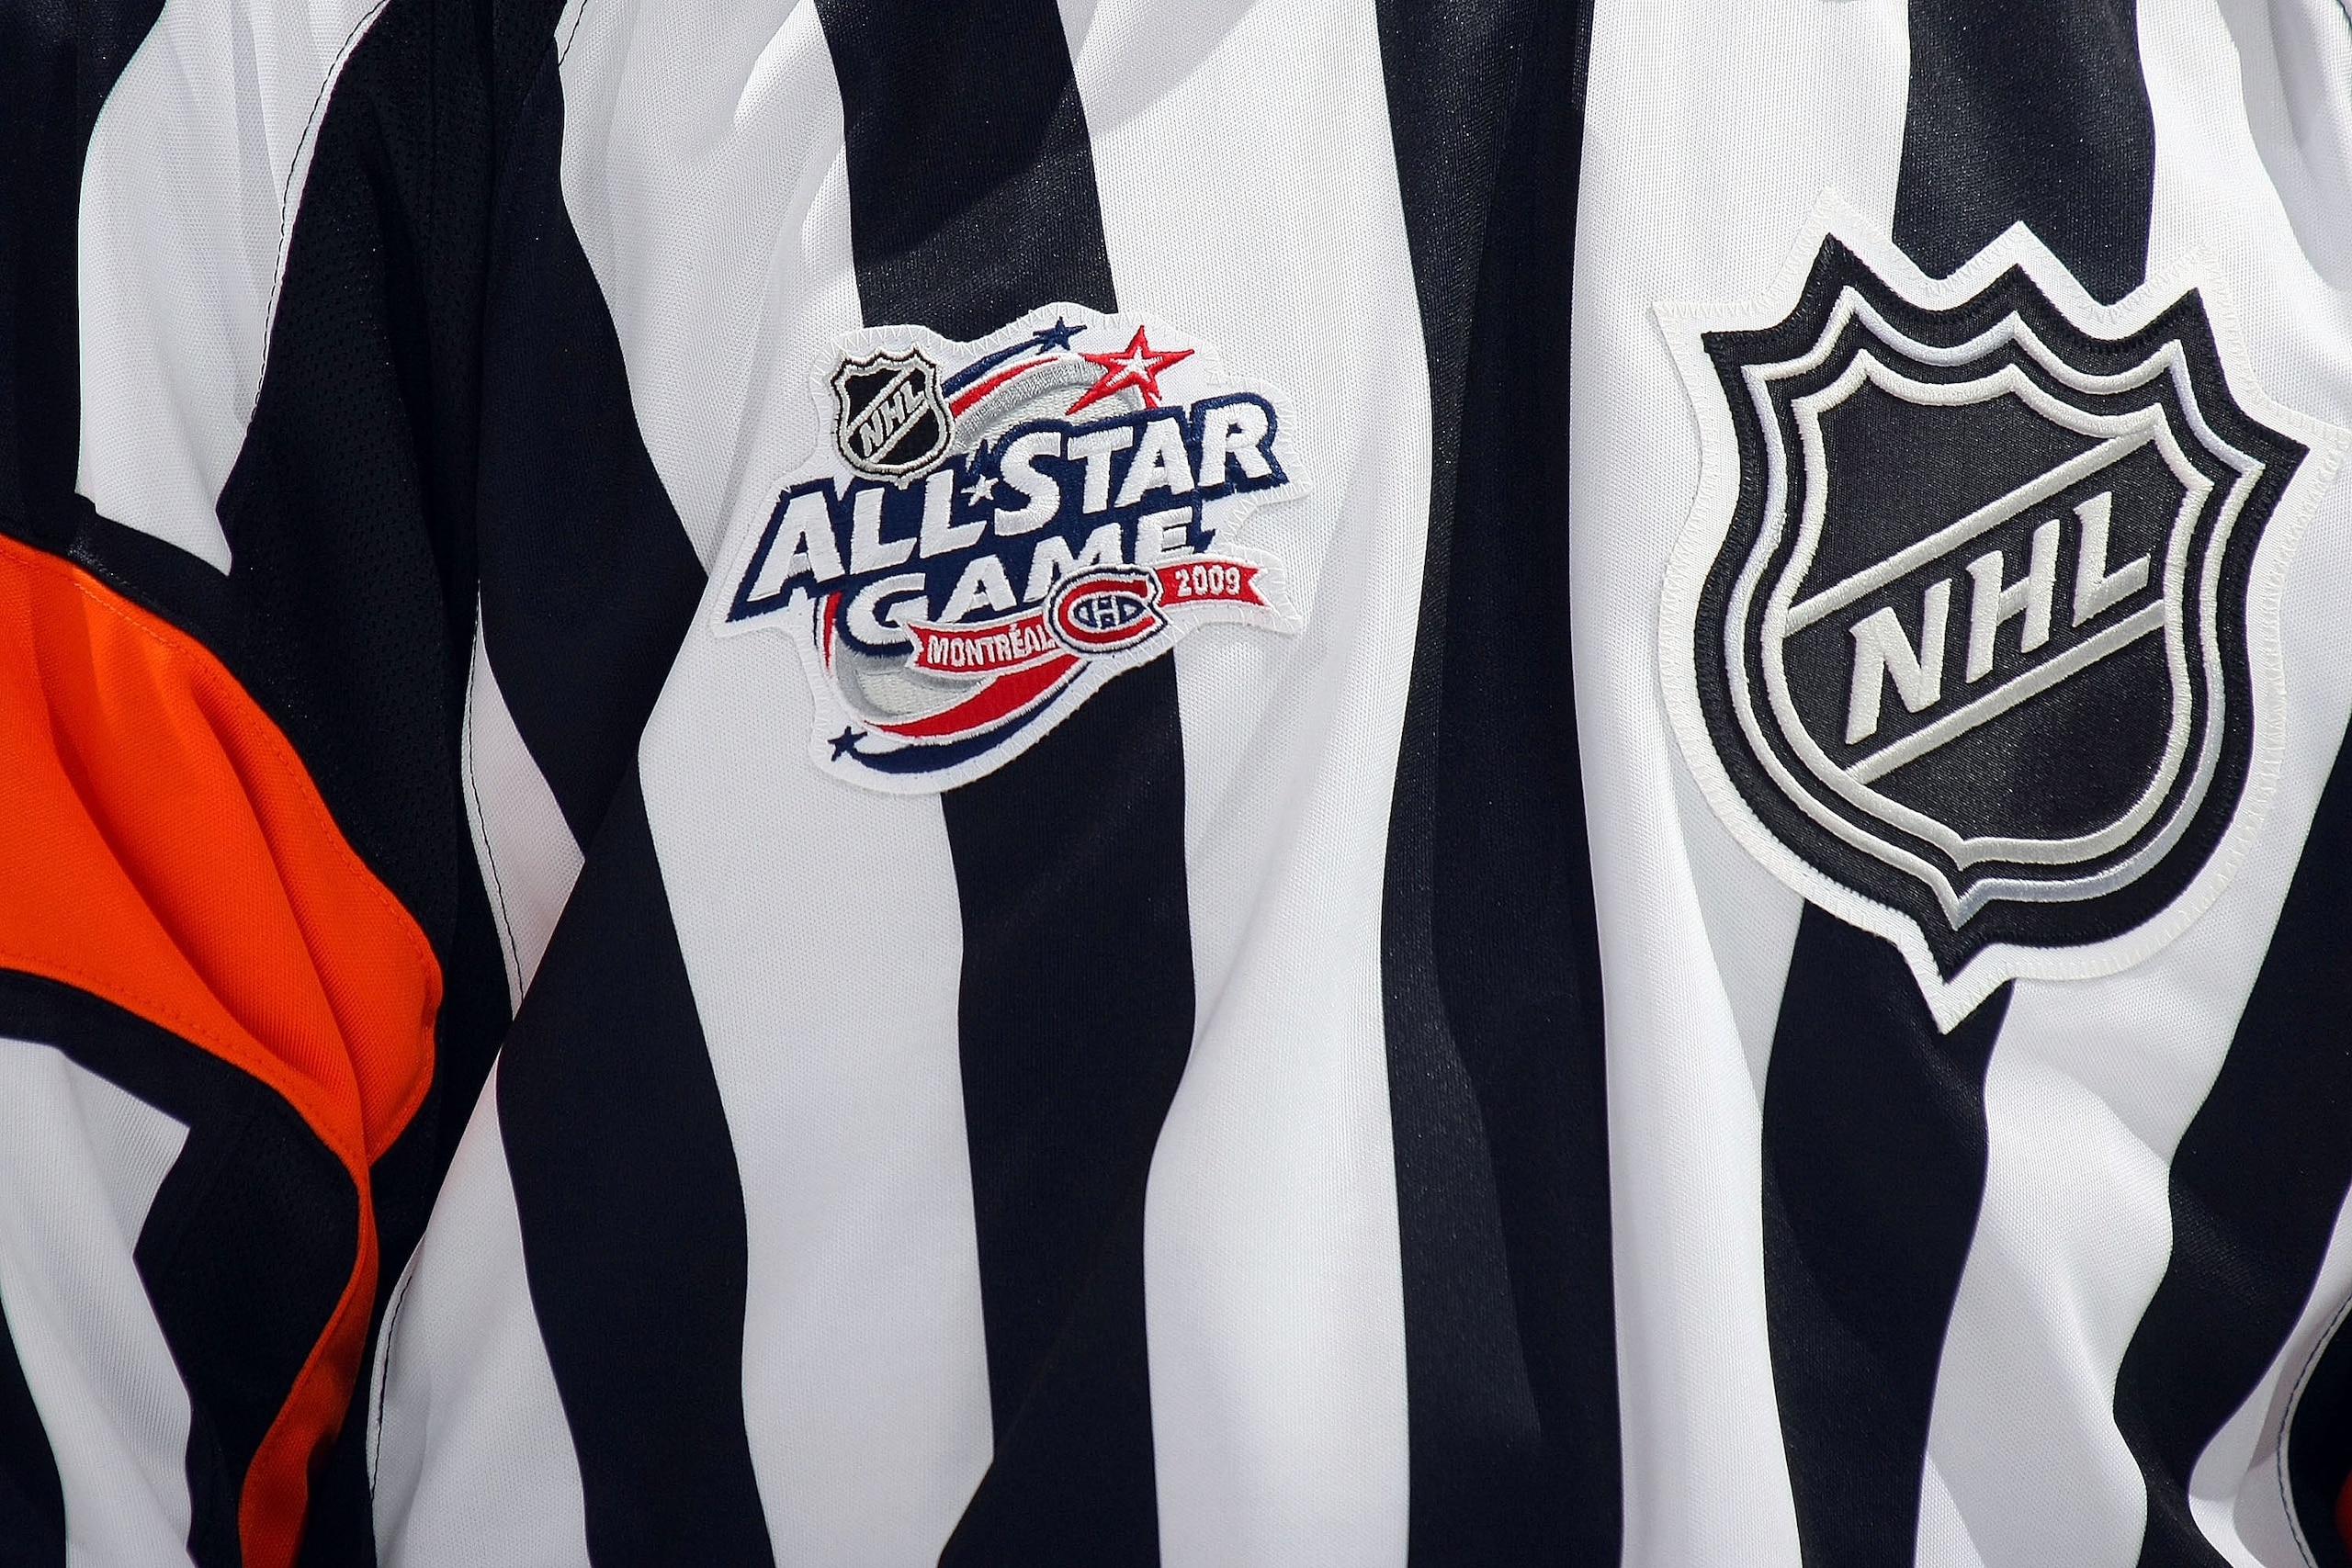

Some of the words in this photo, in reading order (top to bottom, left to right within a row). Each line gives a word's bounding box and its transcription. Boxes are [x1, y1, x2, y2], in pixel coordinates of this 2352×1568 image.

[859, 380, 925, 457] NHL
[750, 469, 989, 603] ALL
[993, 400, 1273, 536] STAR
[847, 507, 1196, 645] GAME
[925, 625, 1058, 668] MONTRÉAL
[1174, 567, 1241, 597] 2009
[1845, 491, 2151, 746] NHL
